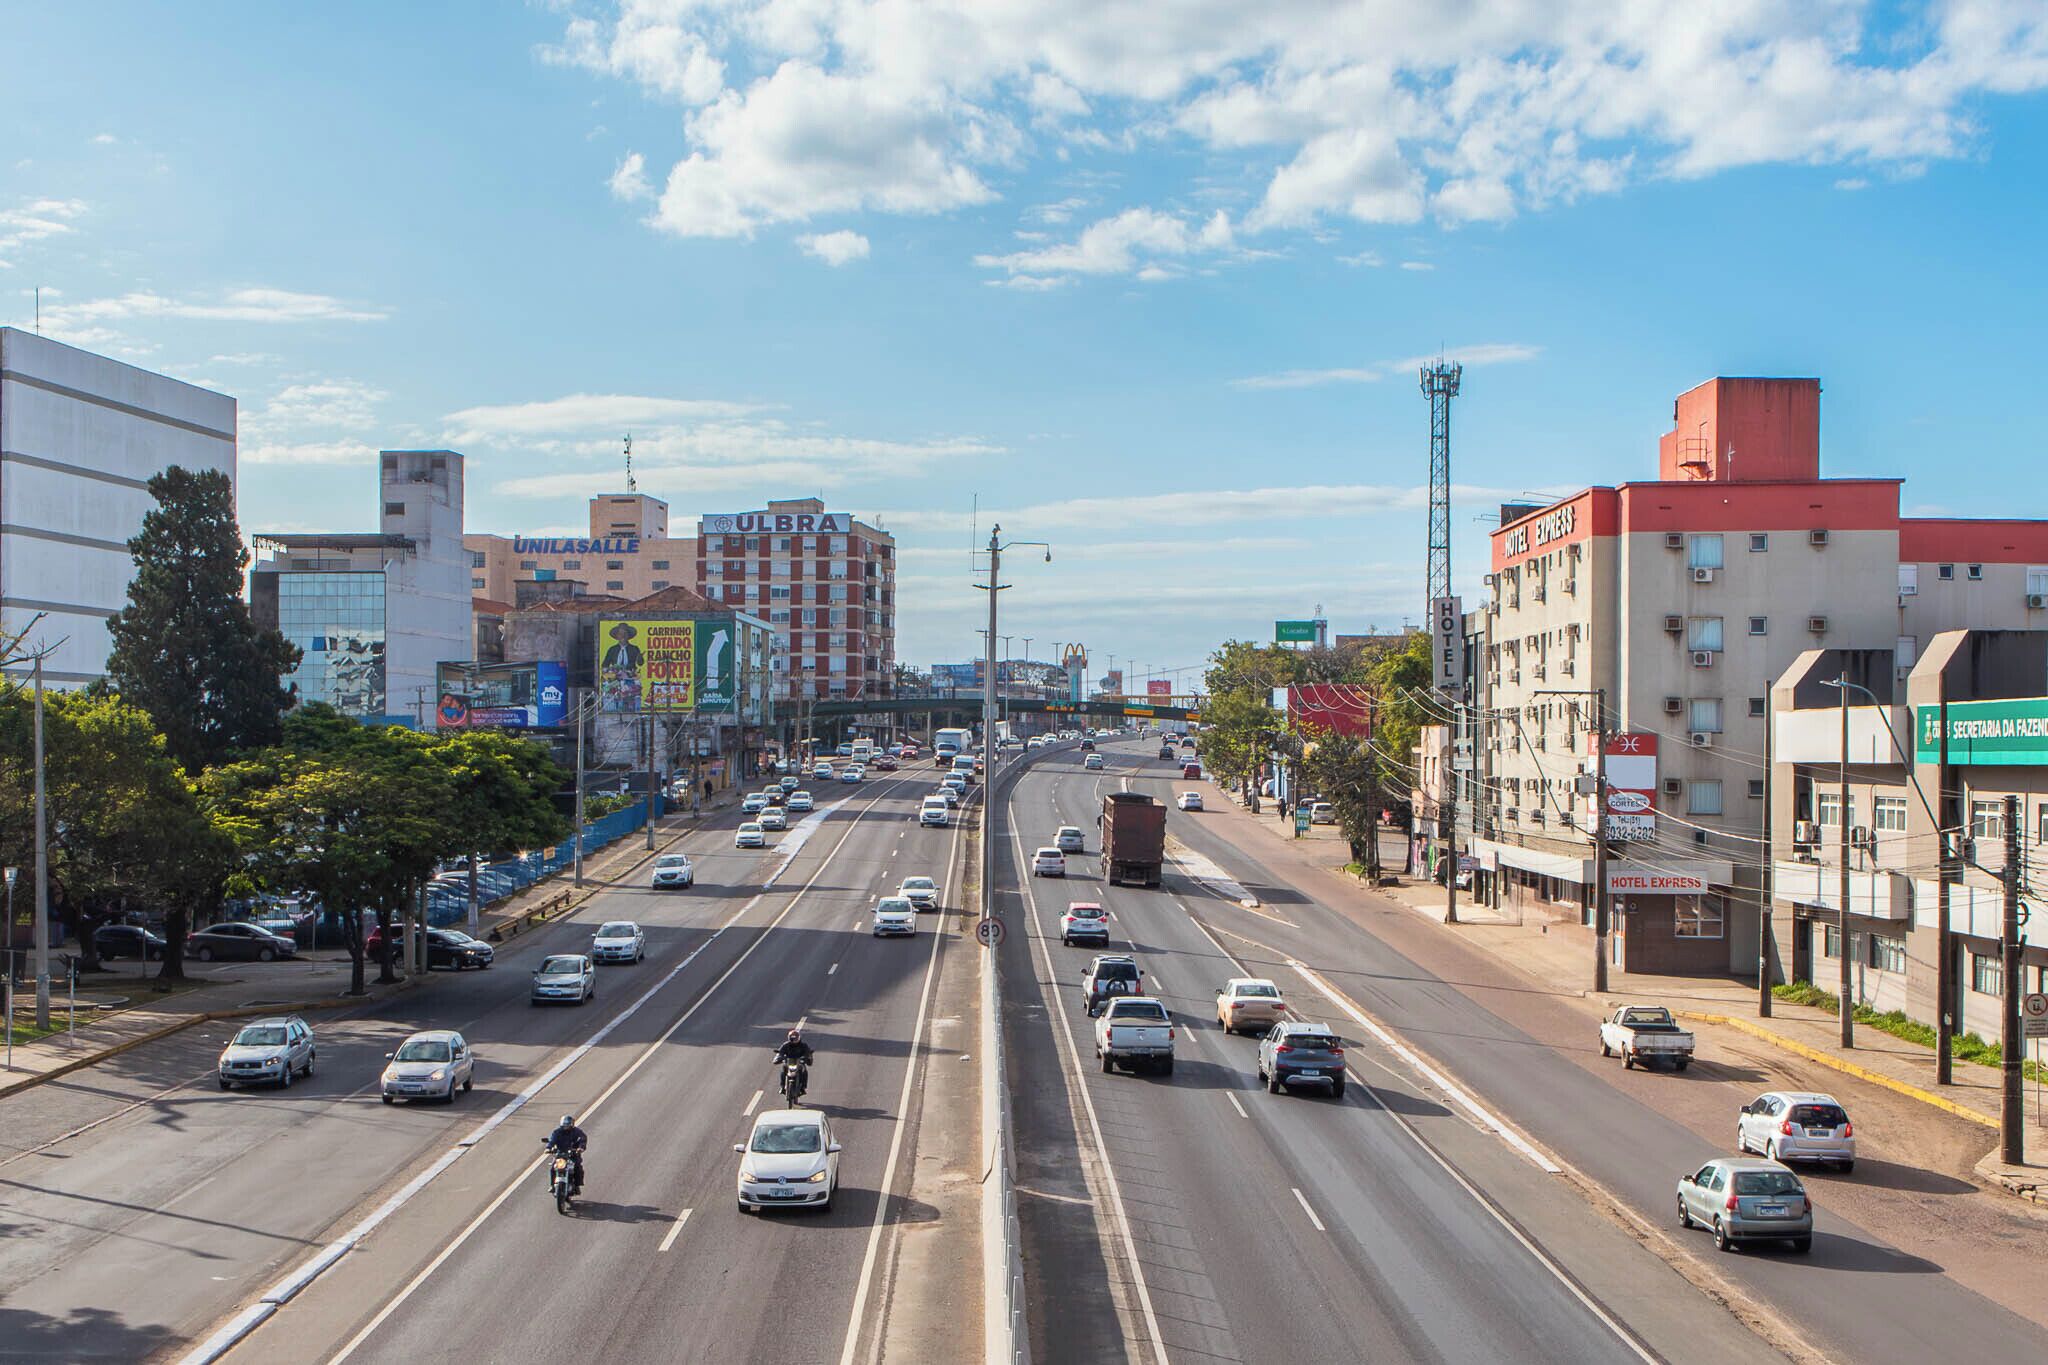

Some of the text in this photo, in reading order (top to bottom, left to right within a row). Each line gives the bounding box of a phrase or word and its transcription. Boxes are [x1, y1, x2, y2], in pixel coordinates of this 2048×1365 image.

[736, 514, 839, 533] ULBRA
[1505, 505, 1576, 558] HOTEL EXPRESS
[513, 537, 640, 554] UNILASALLE
[647, 627, 691, 636] CARRINHO
[647, 637, 691, 649] LOTADO
[1441, 603, 1454, 677] HOTEL
[647, 650, 691, 661] RANCHO
[647, 662, 691, 678] FORT!
[544, 691, 560, 700] my
[1953, 720, 2002, 739] SECRETARIA
[2003, 719, 2015, 738] DA
[1611, 877, 1701, 888] HOTEL EXPRESS
[981, 924, 1000, 937] 80
